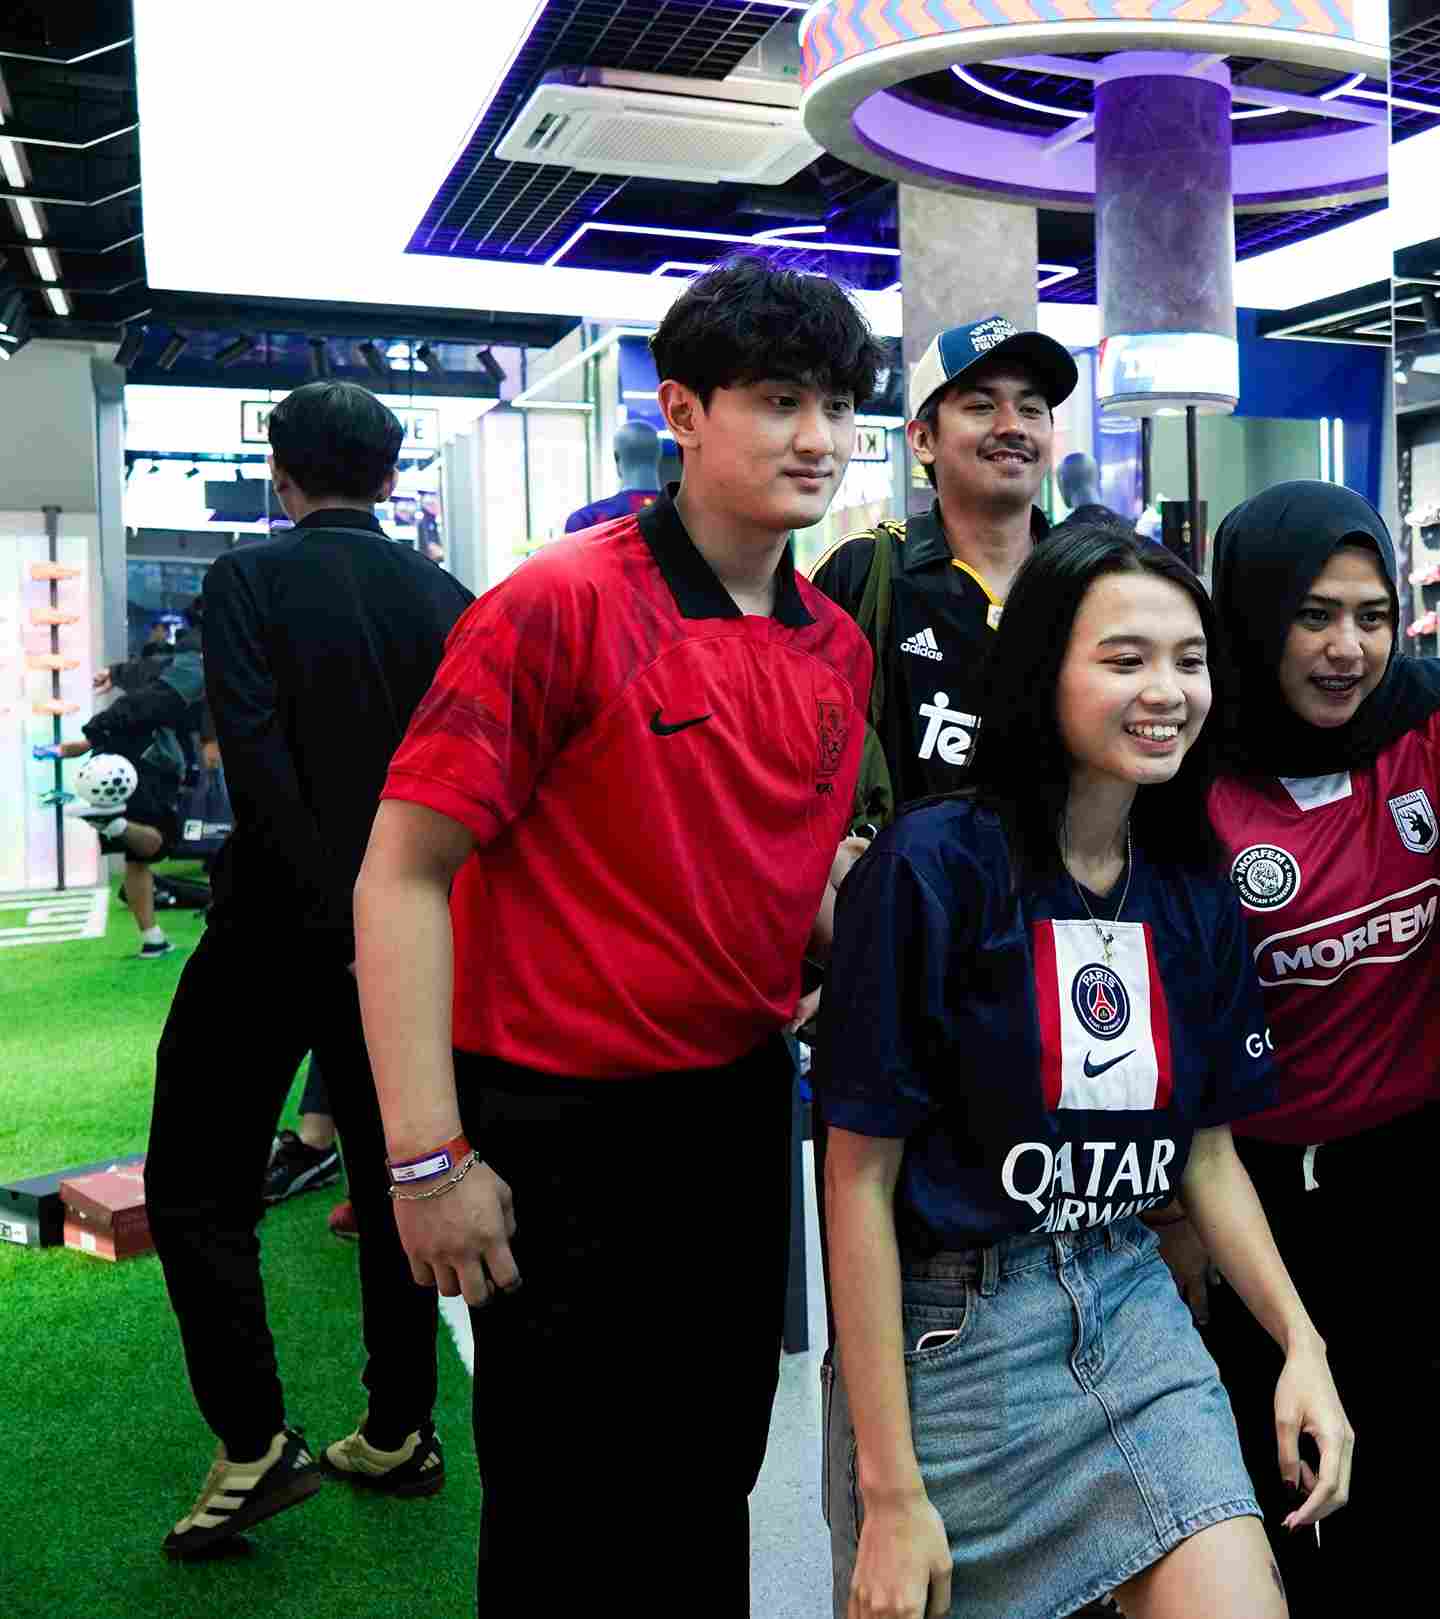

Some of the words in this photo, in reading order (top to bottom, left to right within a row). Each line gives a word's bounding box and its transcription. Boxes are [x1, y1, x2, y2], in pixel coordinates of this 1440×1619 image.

[900, 642, 943, 661] adidas
[918, 691, 982, 766] Te
[1237, 848, 1287, 875] MORFEM
[1271, 895, 1438, 977] MORFEM
[1082, 971, 1117, 989] PARIS
[1001, 1138, 1176, 1214] QATAR
